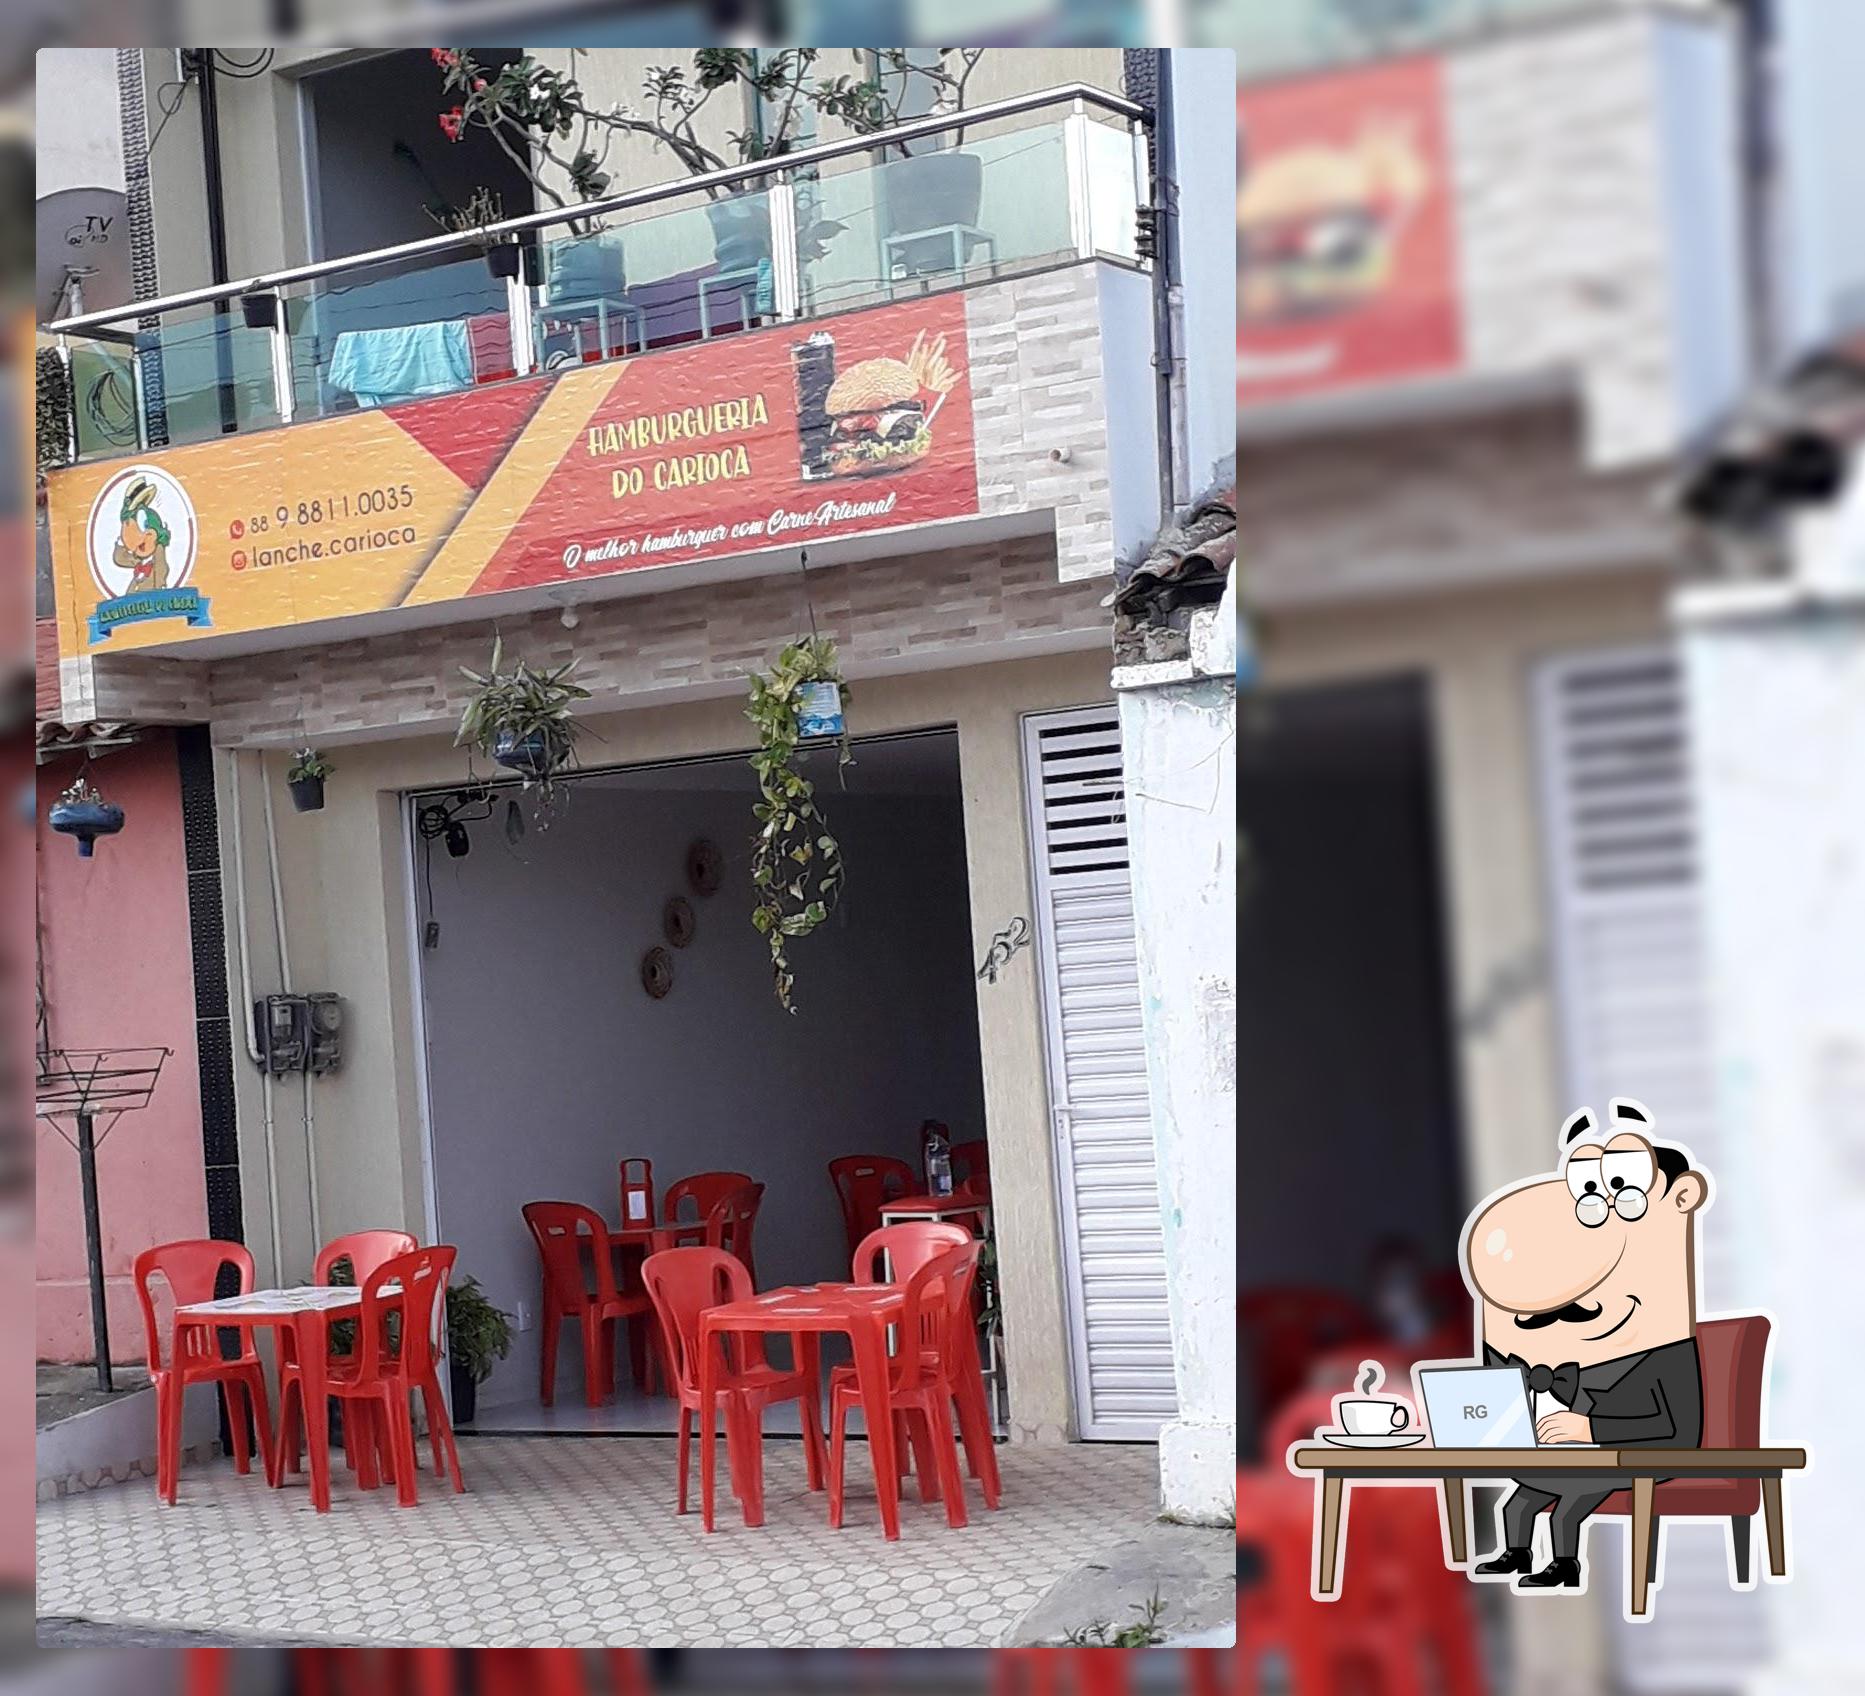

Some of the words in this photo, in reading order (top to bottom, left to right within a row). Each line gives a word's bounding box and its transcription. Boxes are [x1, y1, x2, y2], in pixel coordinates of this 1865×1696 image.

[85, 215, 114, 232] TV
[587, 393, 769, 457] HAMBURGUERIA
[612, 466, 644, 499] DO
[654, 444, 750, 491] CARIOCA
[250, 515, 269, 534] 88
[276, 506, 289, 529] 9
[297, 484, 413, 526] 8811.0035
[563, 544, 582, 569] O
[585, 538, 638, 563] melhor
[640, 523, 729, 554] hamburguer
[731, 519, 765, 539] com
[767, 508, 815, 535] Carne
[813, 491, 897, 526] Artesanal
[252, 527, 416, 568] lanche.carioca
